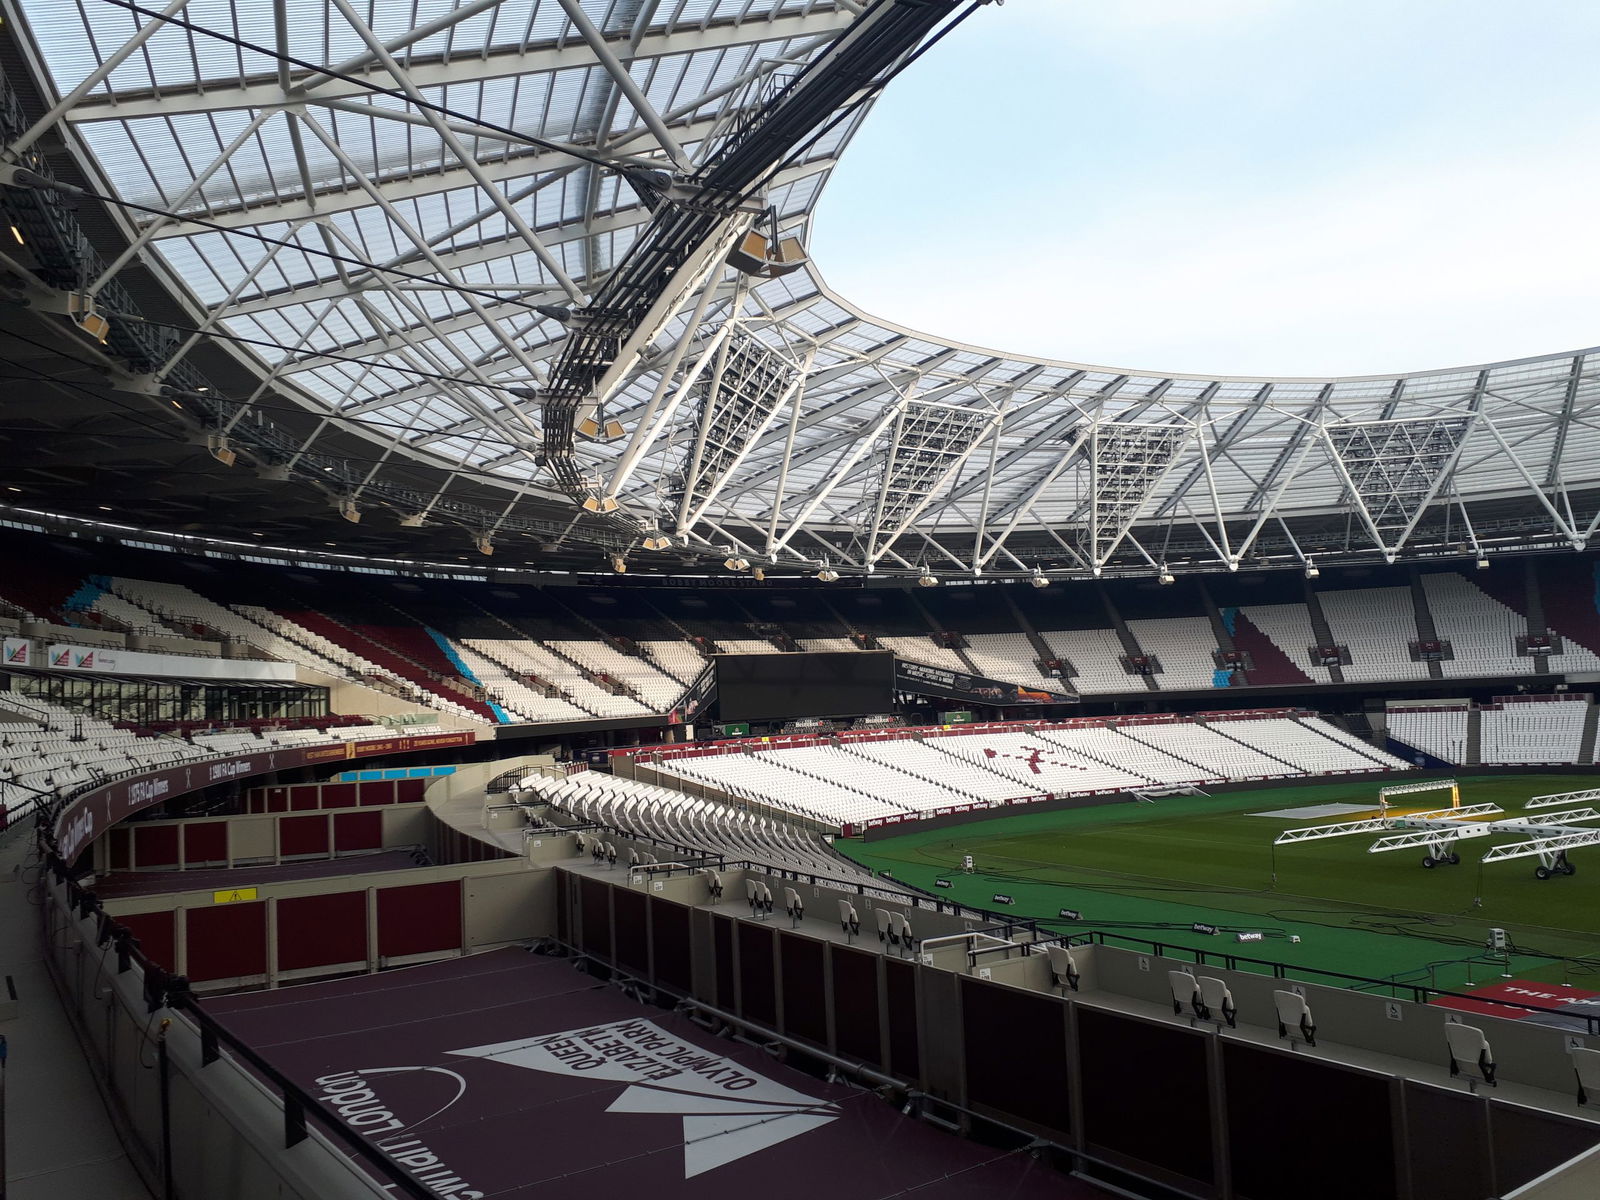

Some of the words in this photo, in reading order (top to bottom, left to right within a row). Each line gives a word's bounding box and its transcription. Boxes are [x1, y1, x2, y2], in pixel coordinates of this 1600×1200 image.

[868, 819, 883, 827] betway
[886, 816, 900, 824] betway
[903, 812, 919, 821] betway
[936, 807, 951, 815] betway
[954, 804, 970, 812] betway
[972, 801, 988, 810] betway
[1504, 986, 1557, 999] THE
[616, 1019, 666, 1050] PARK
[534, 1034, 608, 1071] QUEEN
[574, 1027, 684, 1081] ELIZABETH
[655, 1041, 758, 1091] OLYMPIC
[314, 1070, 405, 1136] London
